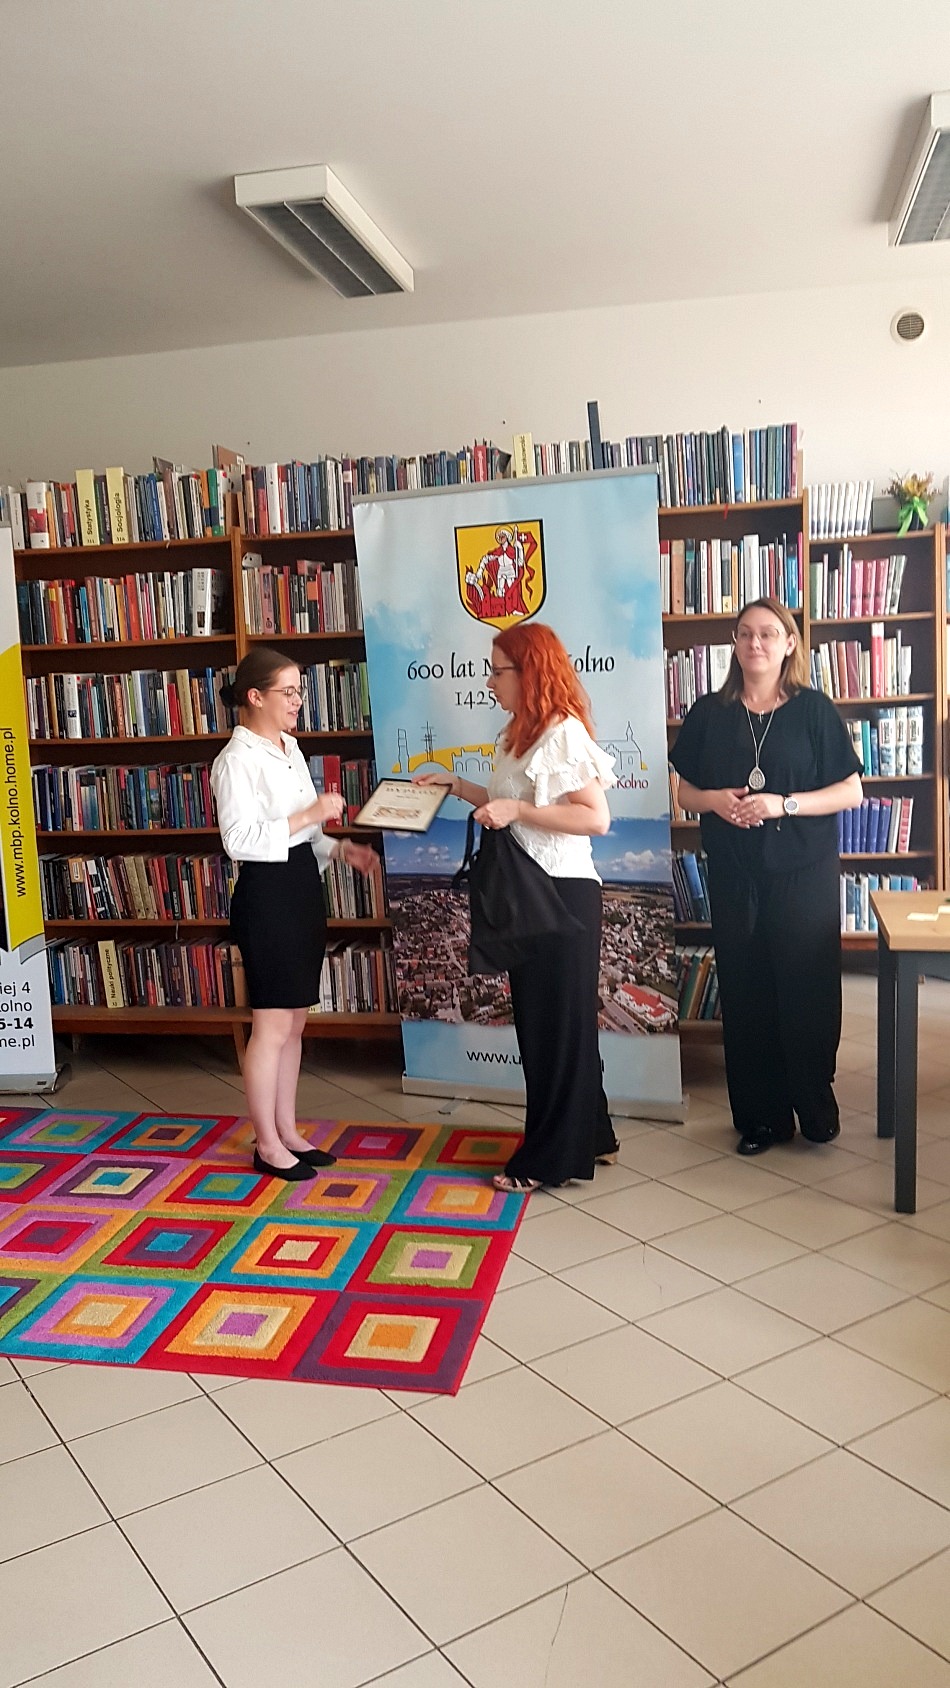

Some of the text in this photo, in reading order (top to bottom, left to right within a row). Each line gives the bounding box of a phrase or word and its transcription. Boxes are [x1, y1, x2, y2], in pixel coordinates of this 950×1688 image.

[84, 499, 93, 535] Statystyka
[115, 492, 124, 533] Socjologia
[407, 660, 444, 680] 600
[450, 652, 476, 678] lat
[568, 645, 615, 673] olno
[455, 690, 497, 710] 1425
[617, 772, 649, 789] Kolno
[0, 728, 26, 898] www.mbp.kolno.home.pl
[105, 948, 114, 980] polityczne
[21, 981, 31, 994] 4
[0, 1000, 33, 1013] olno
